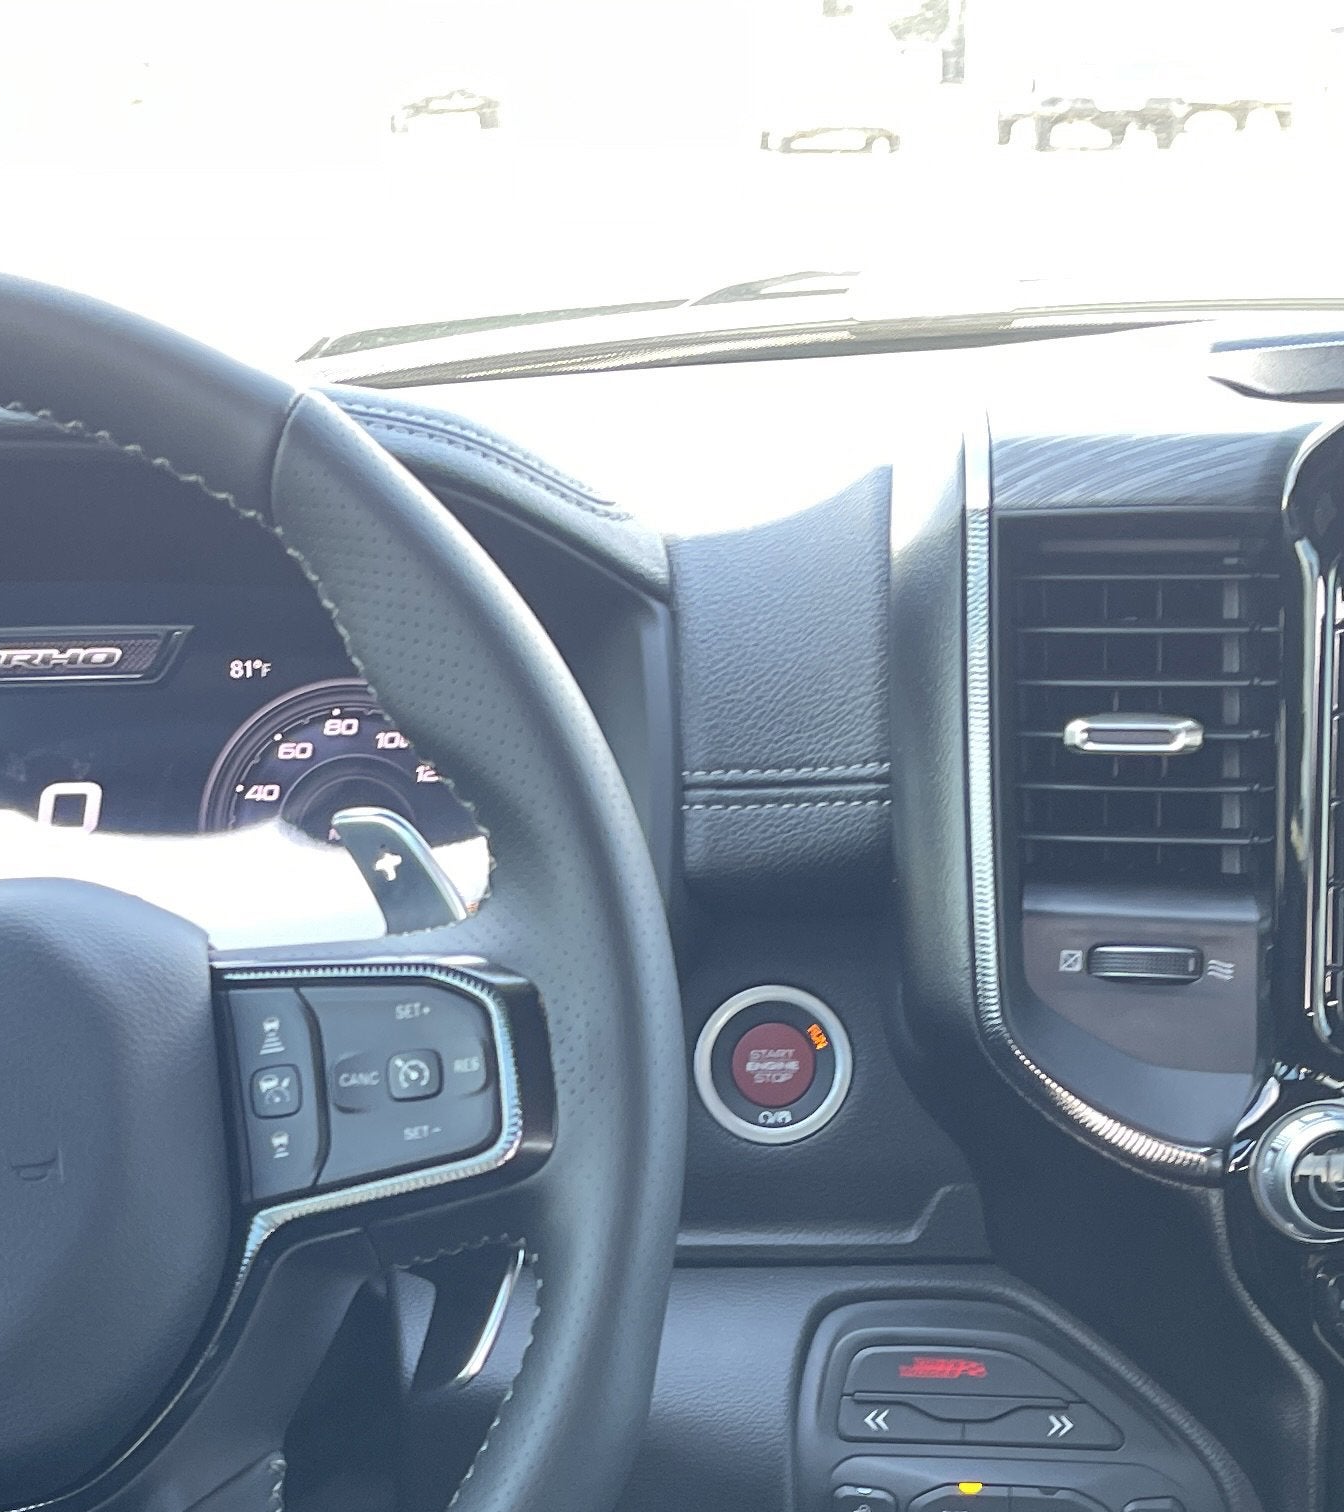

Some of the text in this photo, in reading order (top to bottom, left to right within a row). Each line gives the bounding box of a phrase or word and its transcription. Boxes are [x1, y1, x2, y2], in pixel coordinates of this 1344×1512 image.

[323, 718, 359, 736] 80
[277, 742, 313, 760] 60
[244, 784, 280, 802] 40
[750, 1048, 796, 1061] START
[453, 1056, 481, 1074] RES
[745, 1060, 800, 1073] ENGINE
[338, 1070, 382, 1088] CANC
[754, 1072, 794, 1084] STOP
